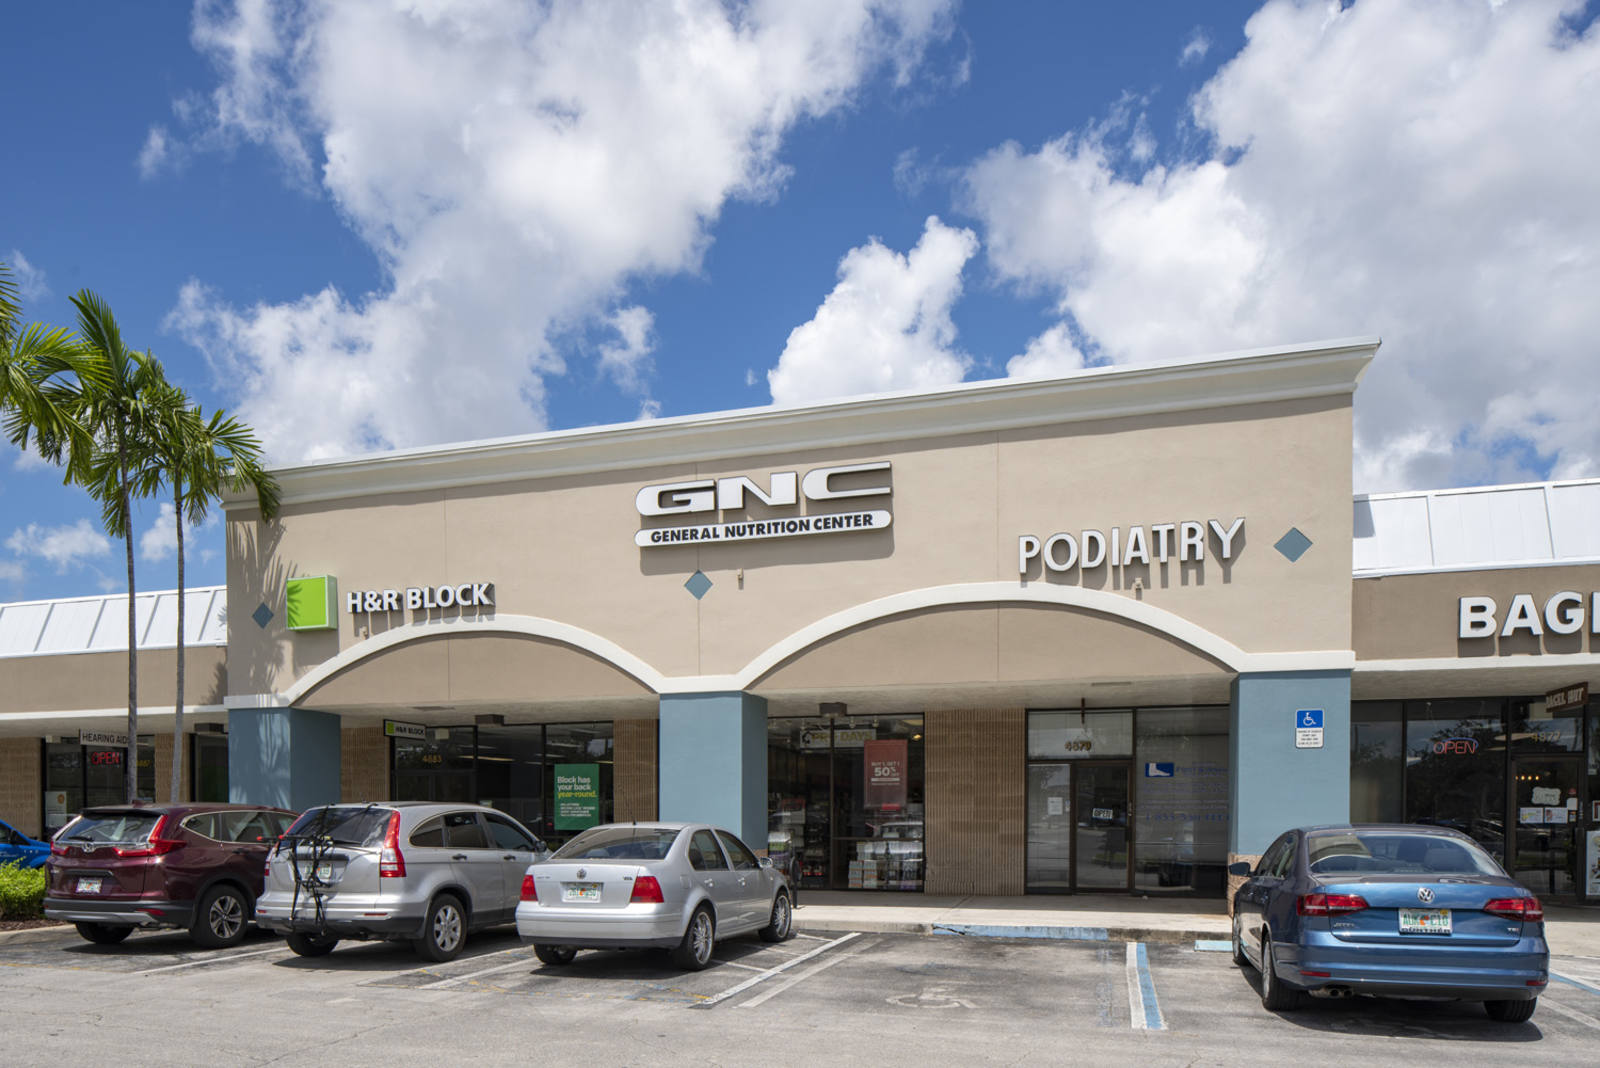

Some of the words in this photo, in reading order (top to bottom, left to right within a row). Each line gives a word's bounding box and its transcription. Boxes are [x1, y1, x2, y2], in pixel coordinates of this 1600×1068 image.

[635, 461, 891, 516] GNC
[651, 528, 720, 543] GENERAL
[724, 519, 810, 538] NUTRITION
[814, 513, 873, 530] CENTER
[1019, 517, 1245, 574] PODIATRY
[347, 589, 400, 613] H&R
[406, 583, 494, 609] BLOCK
[82, 733, 115, 743] HEARING
[116, 735, 128, 744] AID
[1433, 741, 1476, 754] OPEN
[91, 752, 120, 765] OPEN
[557, 776, 576, 784] Block
[577, 776, 591, 784] has
[557, 784, 572, 792] your
